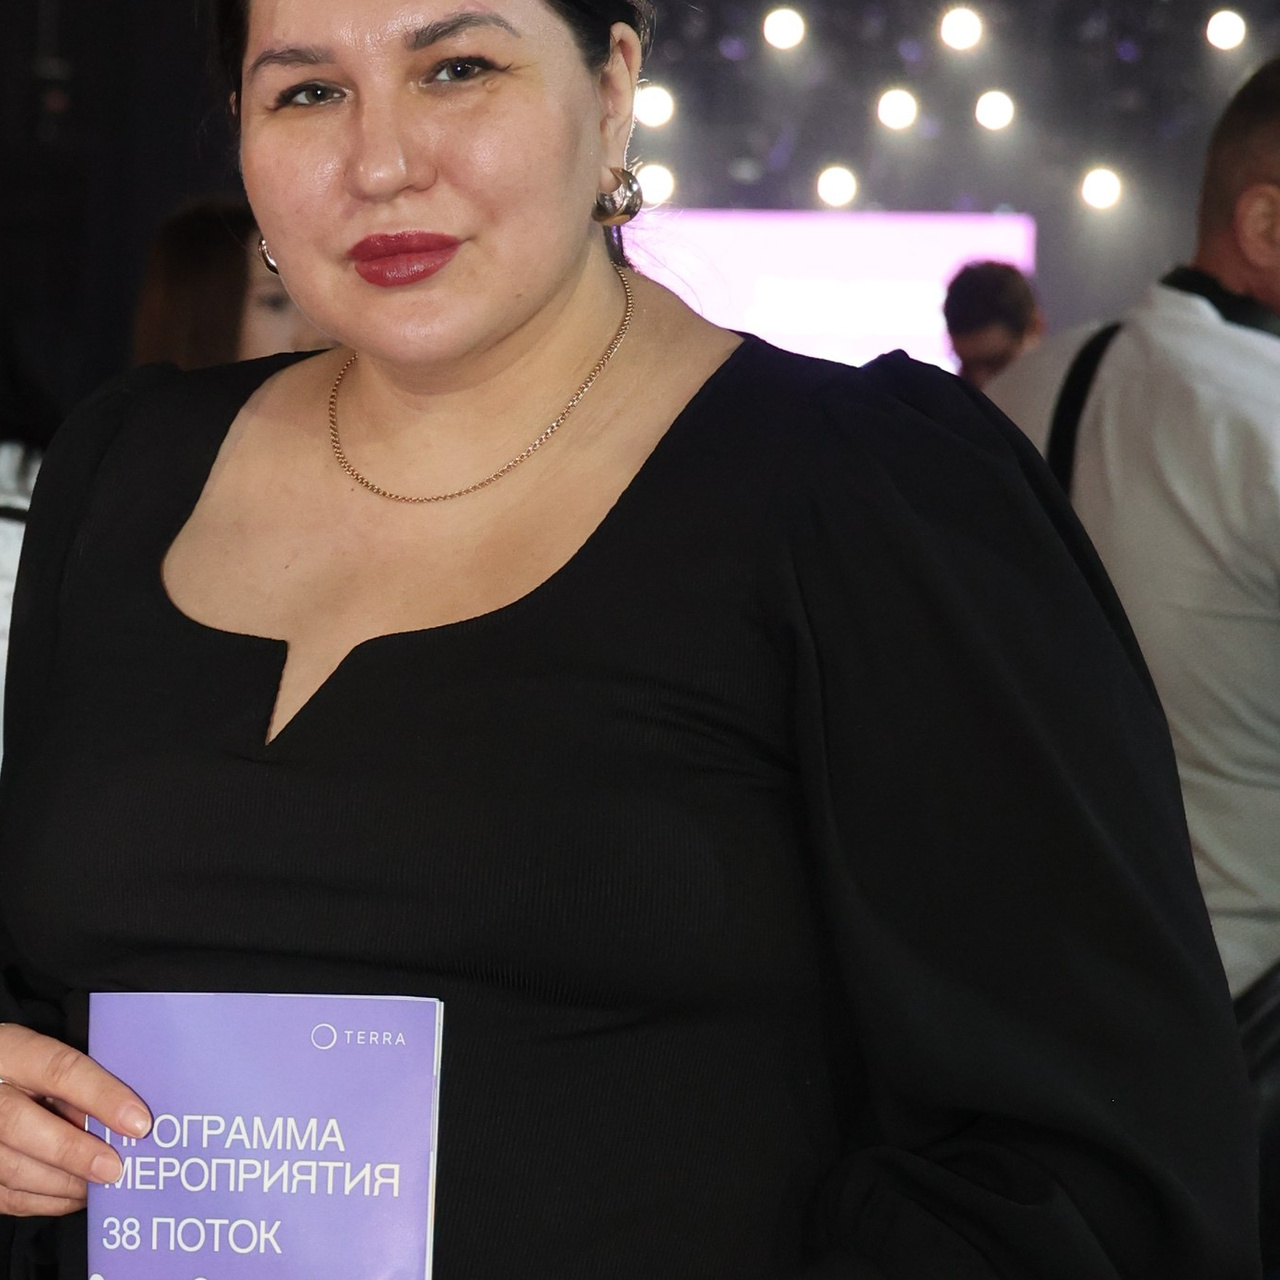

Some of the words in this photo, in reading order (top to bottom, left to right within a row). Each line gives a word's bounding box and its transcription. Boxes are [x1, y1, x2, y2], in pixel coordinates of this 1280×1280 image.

[344, 1030, 406, 1046] TERRA
[105, 1113, 345, 1152] ОГРАММА
[102, 1217, 141, 1250] 38
[151, 1217, 283, 1254] ПОТОК
